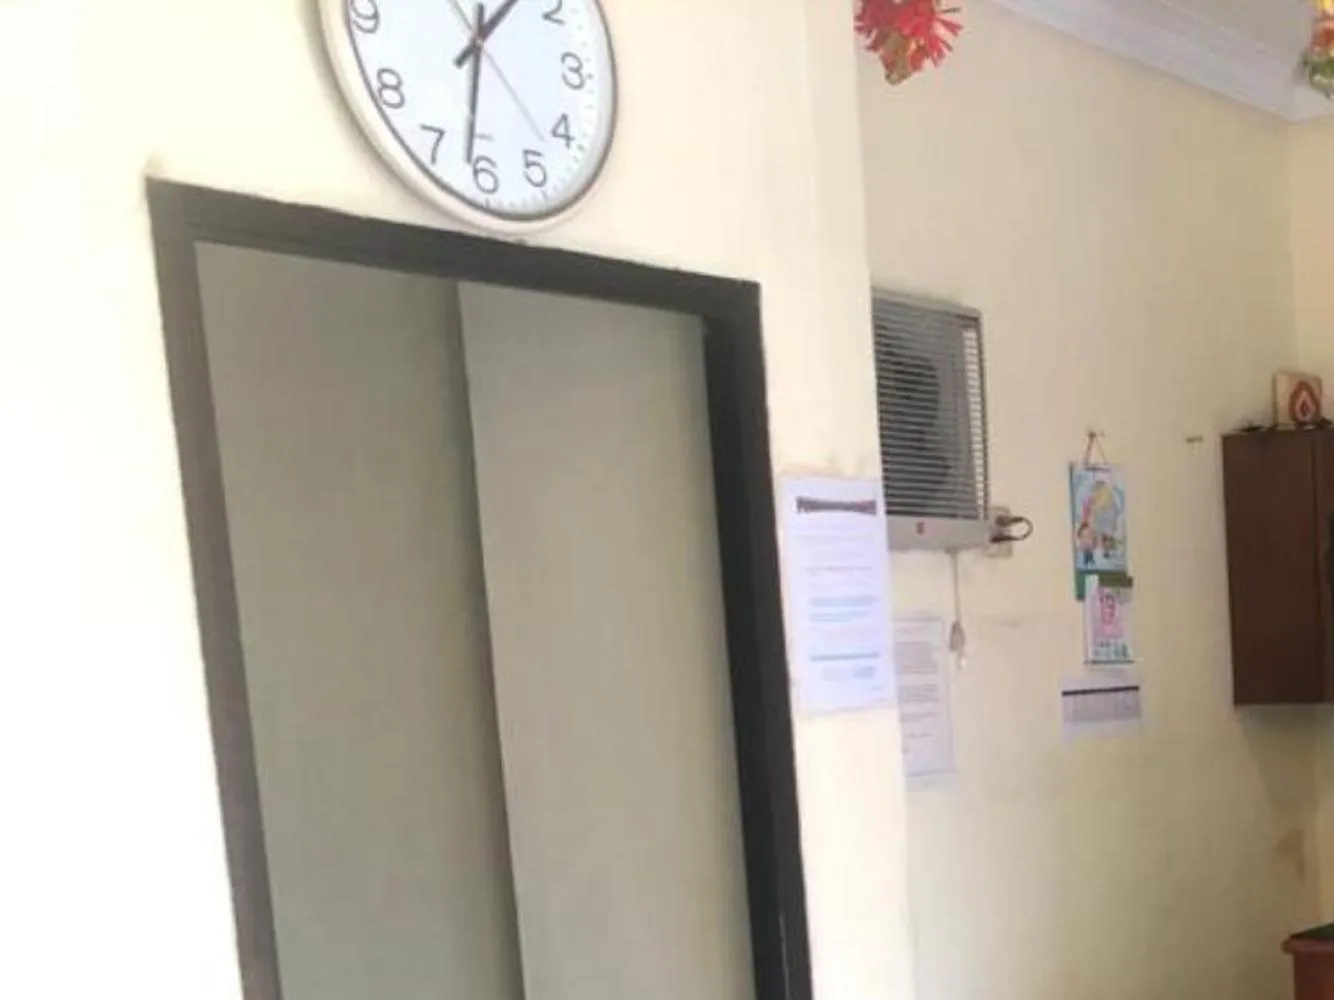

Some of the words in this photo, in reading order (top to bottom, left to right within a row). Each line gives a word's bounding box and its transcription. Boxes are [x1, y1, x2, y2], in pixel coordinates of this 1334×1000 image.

[350, 0, 380, 34] 9
[375, 67, 406, 110] 8
[560, 51, 586, 91] 3
[419, 122, 447, 165] 7
[550, 112, 575, 150] 4
[472, 154, 500, 196] 6
[522, 148, 548, 189] 5
